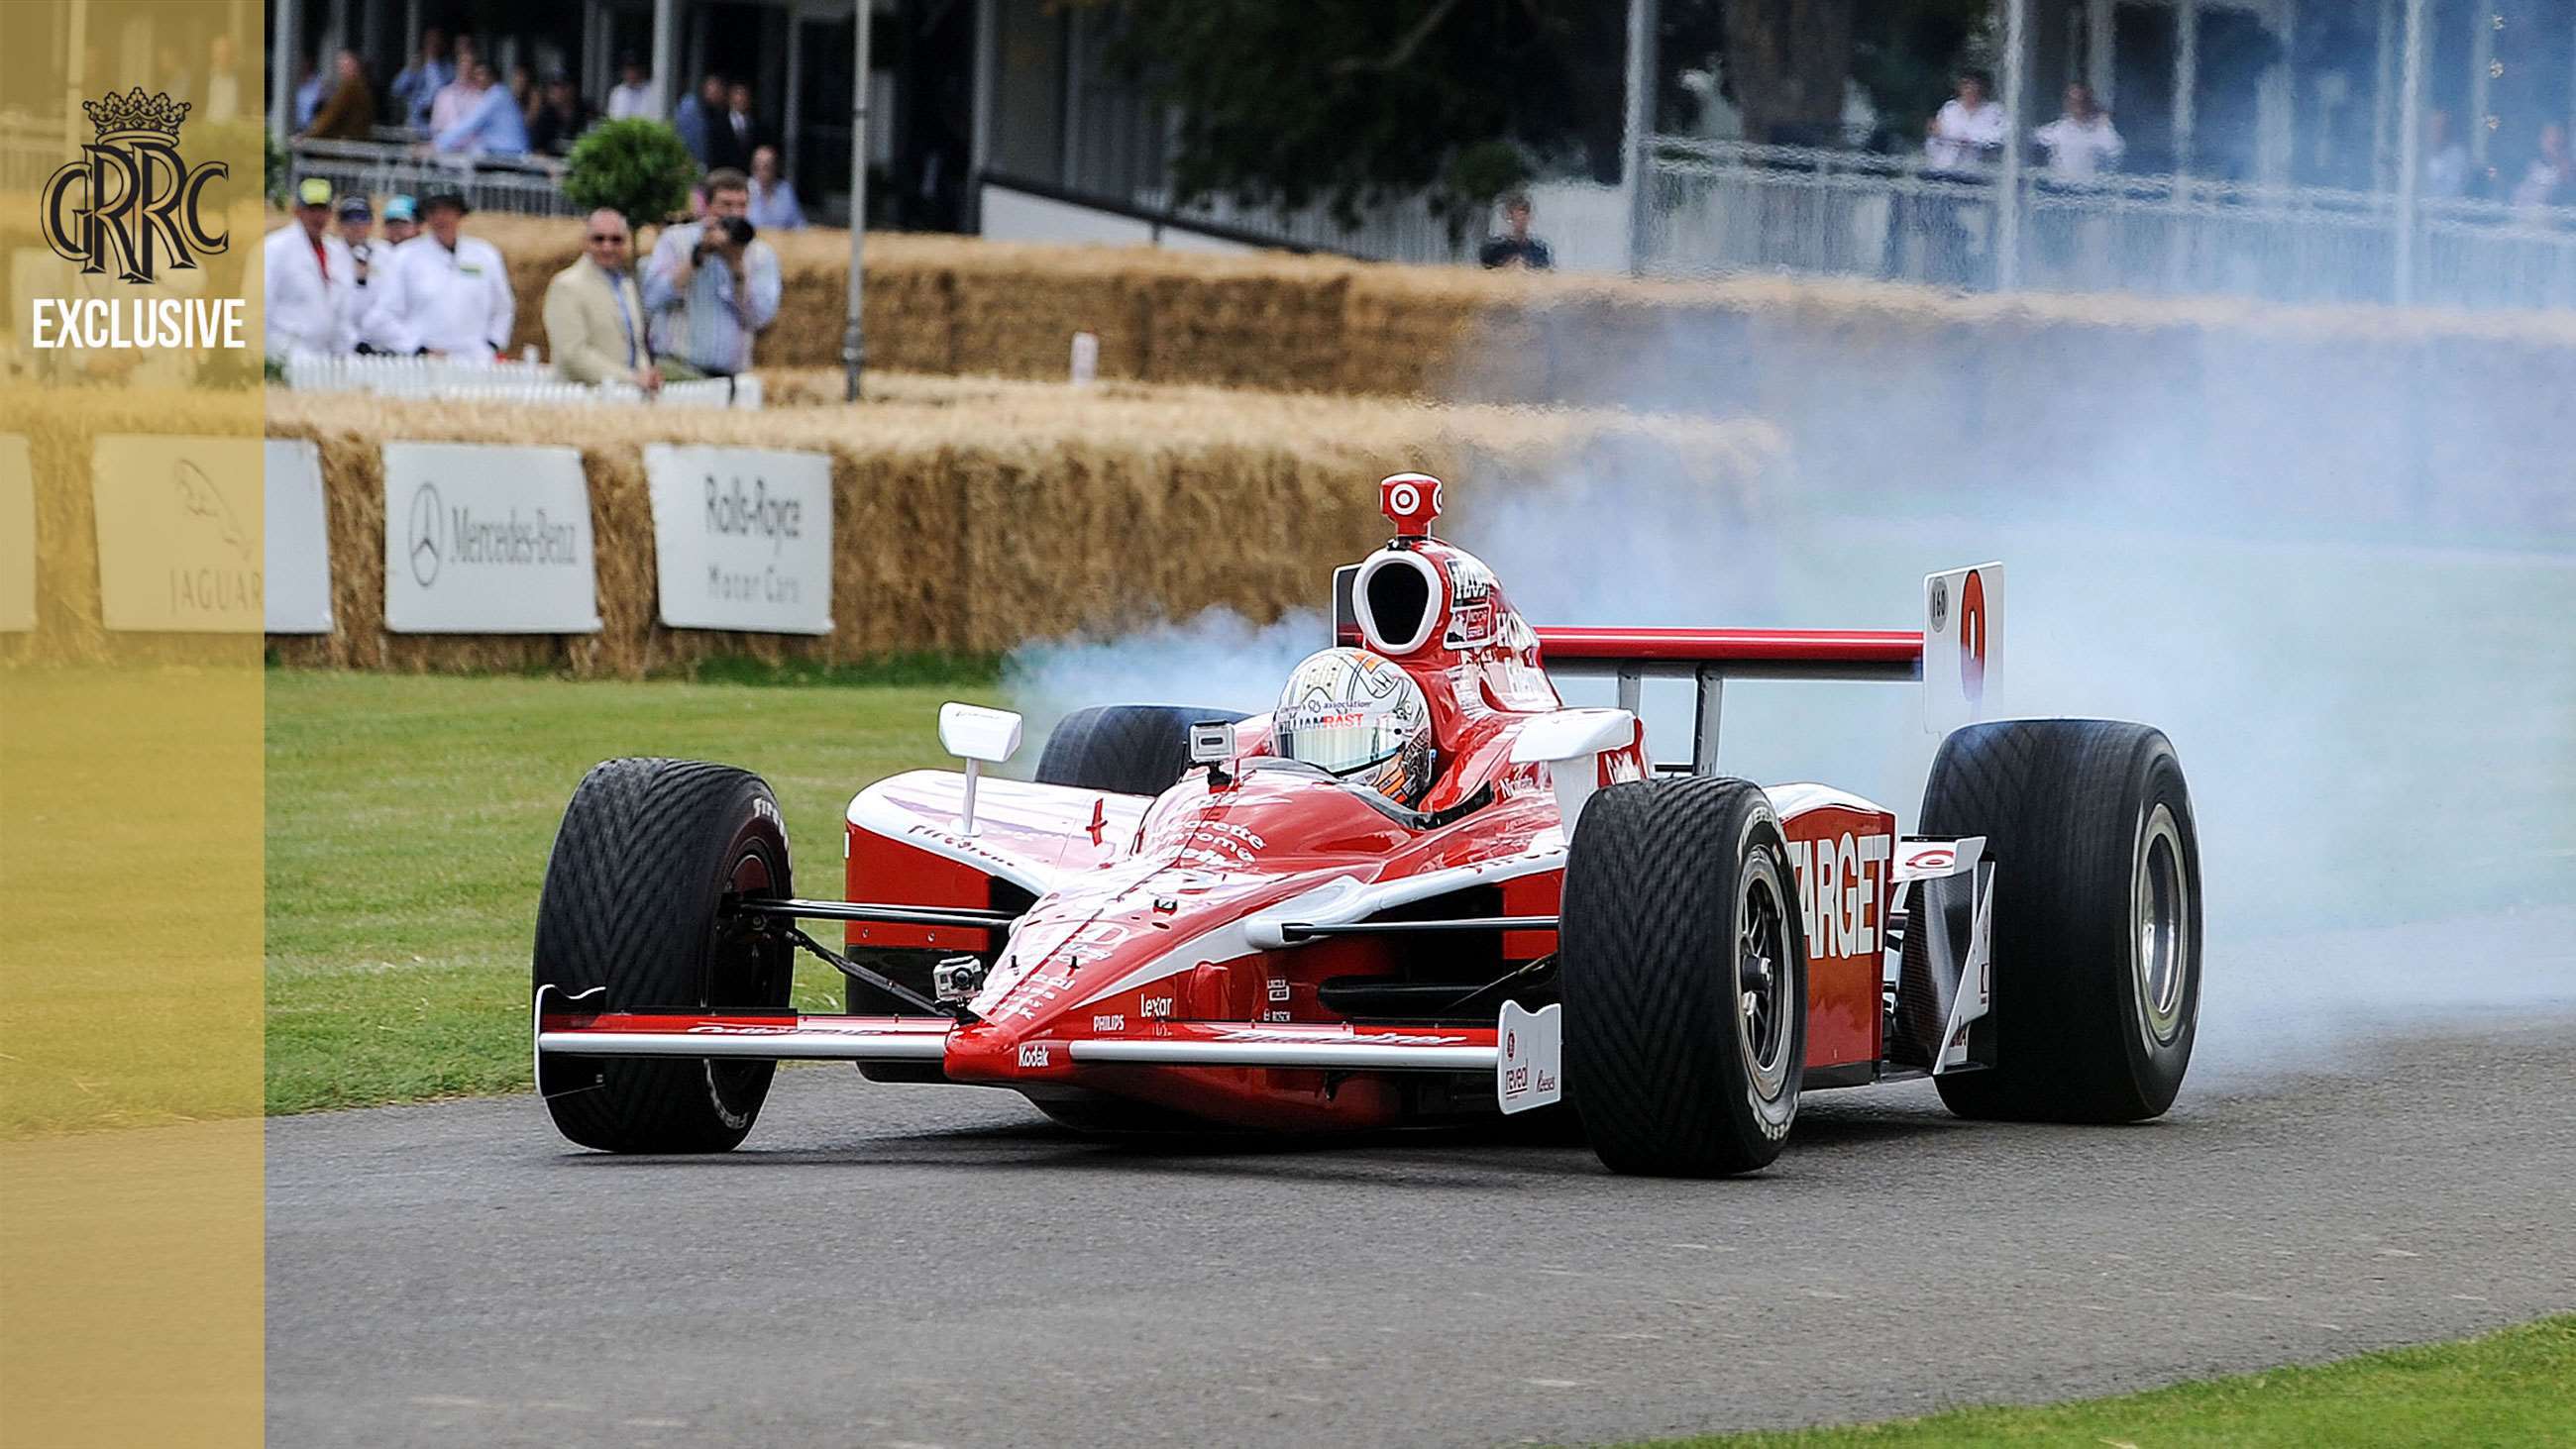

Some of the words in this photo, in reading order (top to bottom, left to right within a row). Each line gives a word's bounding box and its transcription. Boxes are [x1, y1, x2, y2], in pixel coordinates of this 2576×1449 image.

[704, 473, 802, 557] Rolls-Royce
[451, 507, 579, 566] Mercedes-Benz
[707, 565, 760, 600] Motor
[765, 565, 800, 604] Cars
[1140, 993, 1172, 1018] Lexar
[1093, 1014, 1125, 1033] PHILIPS
[1019, 1046, 1050, 1068] Kodak
